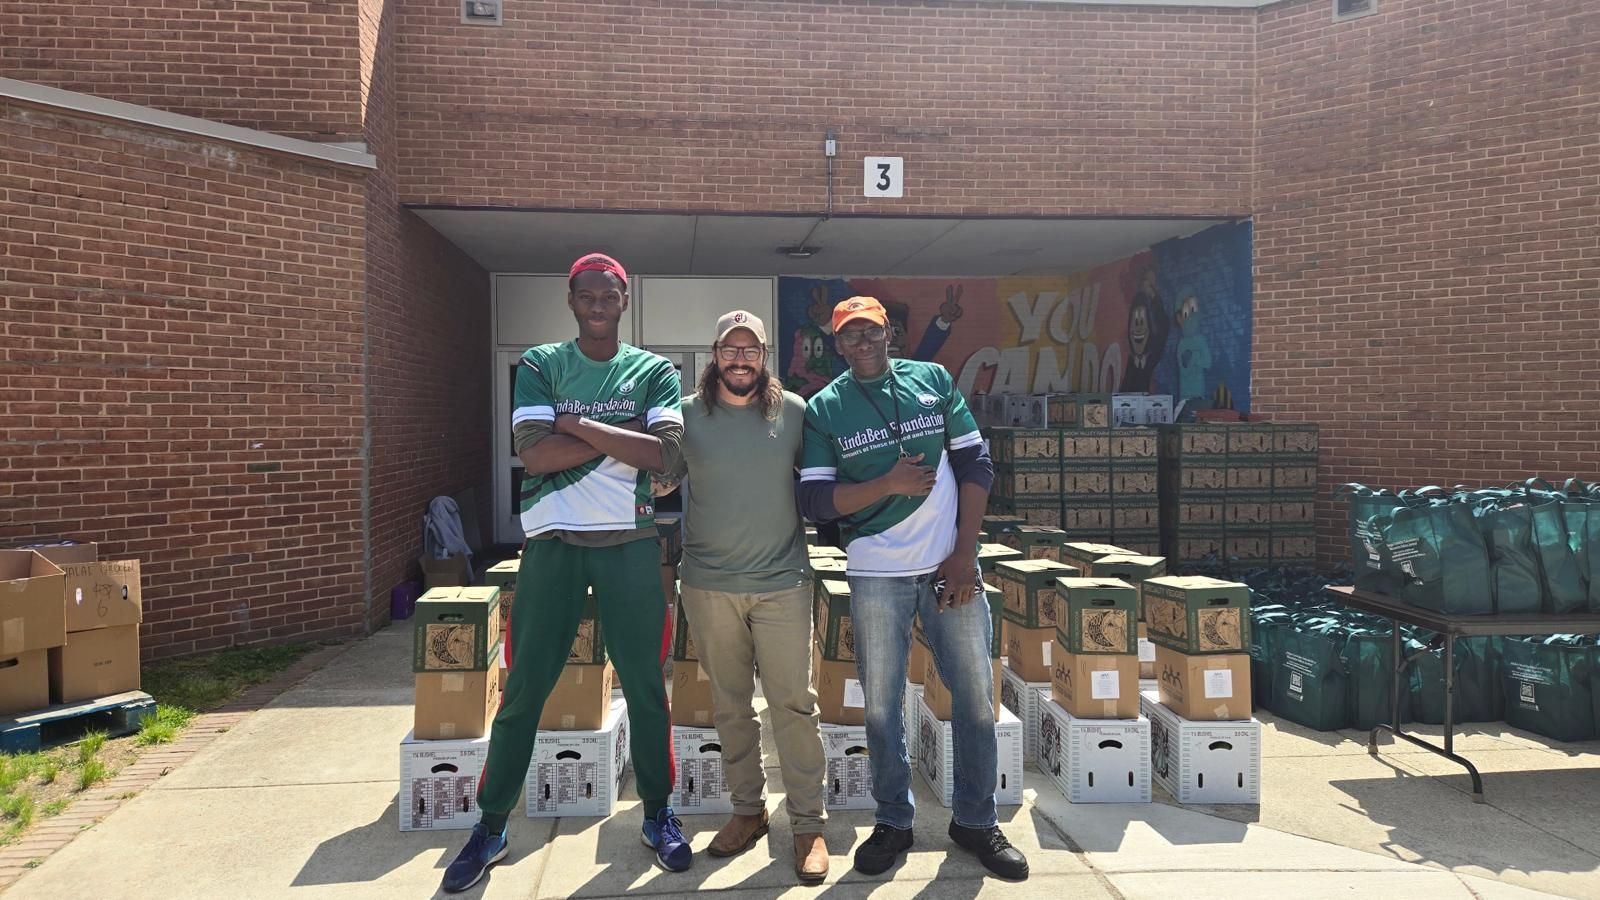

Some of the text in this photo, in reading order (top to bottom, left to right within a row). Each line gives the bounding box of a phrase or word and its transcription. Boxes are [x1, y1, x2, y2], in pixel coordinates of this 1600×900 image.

[876, 163, 891, 191] 3
[1007, 283, 1100, 344] YOU
[957, 345, 1075, 396] CAN
[838, 428, 888, 451] LindaBen
